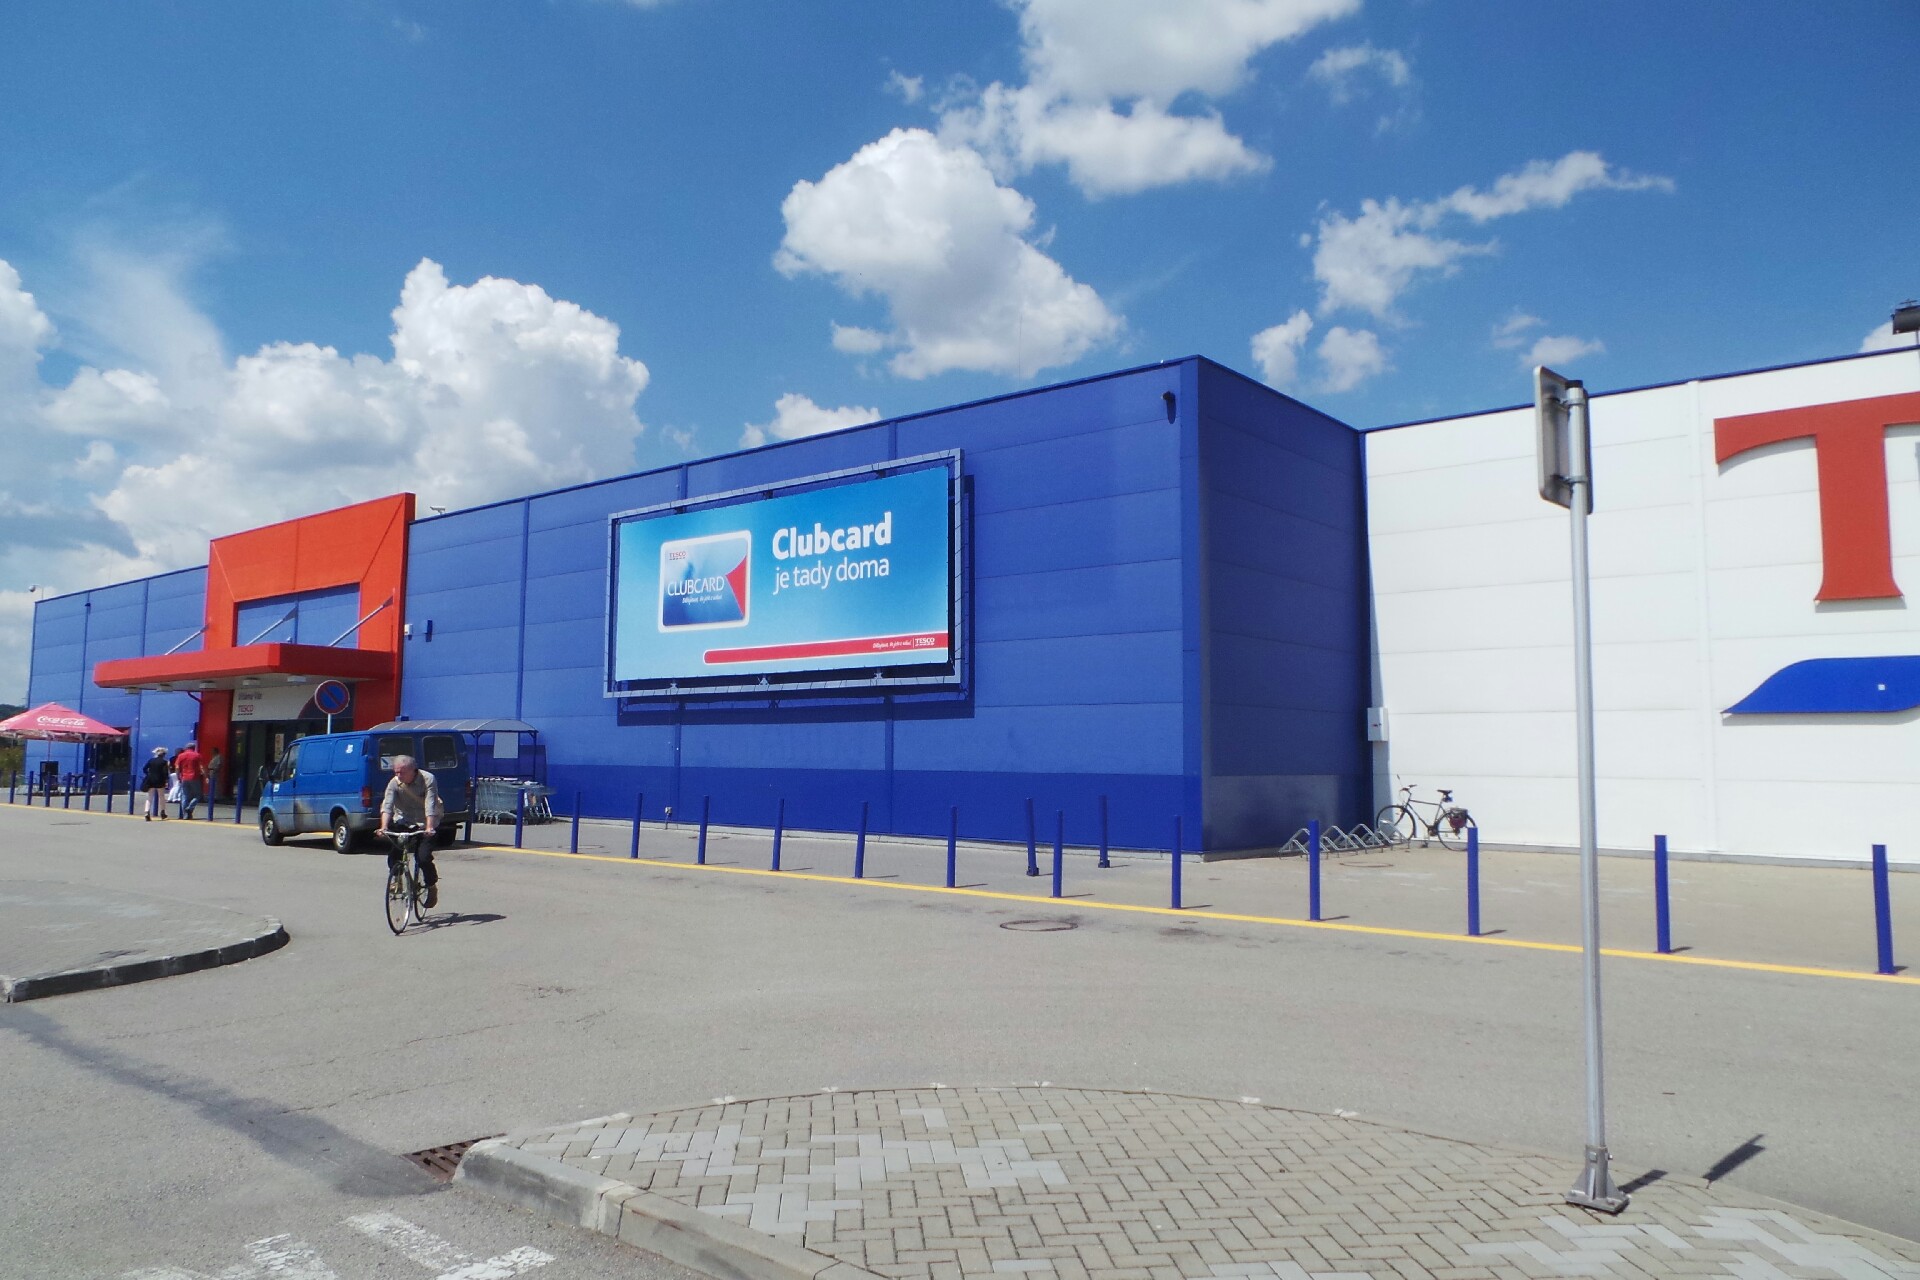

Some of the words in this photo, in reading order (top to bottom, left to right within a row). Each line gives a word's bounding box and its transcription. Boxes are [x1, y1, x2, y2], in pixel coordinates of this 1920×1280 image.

[772, 511, 892, 560] Clubcard
[669, 550, 687, 559] TESCO
[772, 566, 790, 595] je
[793, 559, 833, 589] tady
[835, 556, 890, 581] doma
[667, 576, 725, 596] CLUBCARD
[914, 637, 936, 646] TESCO
